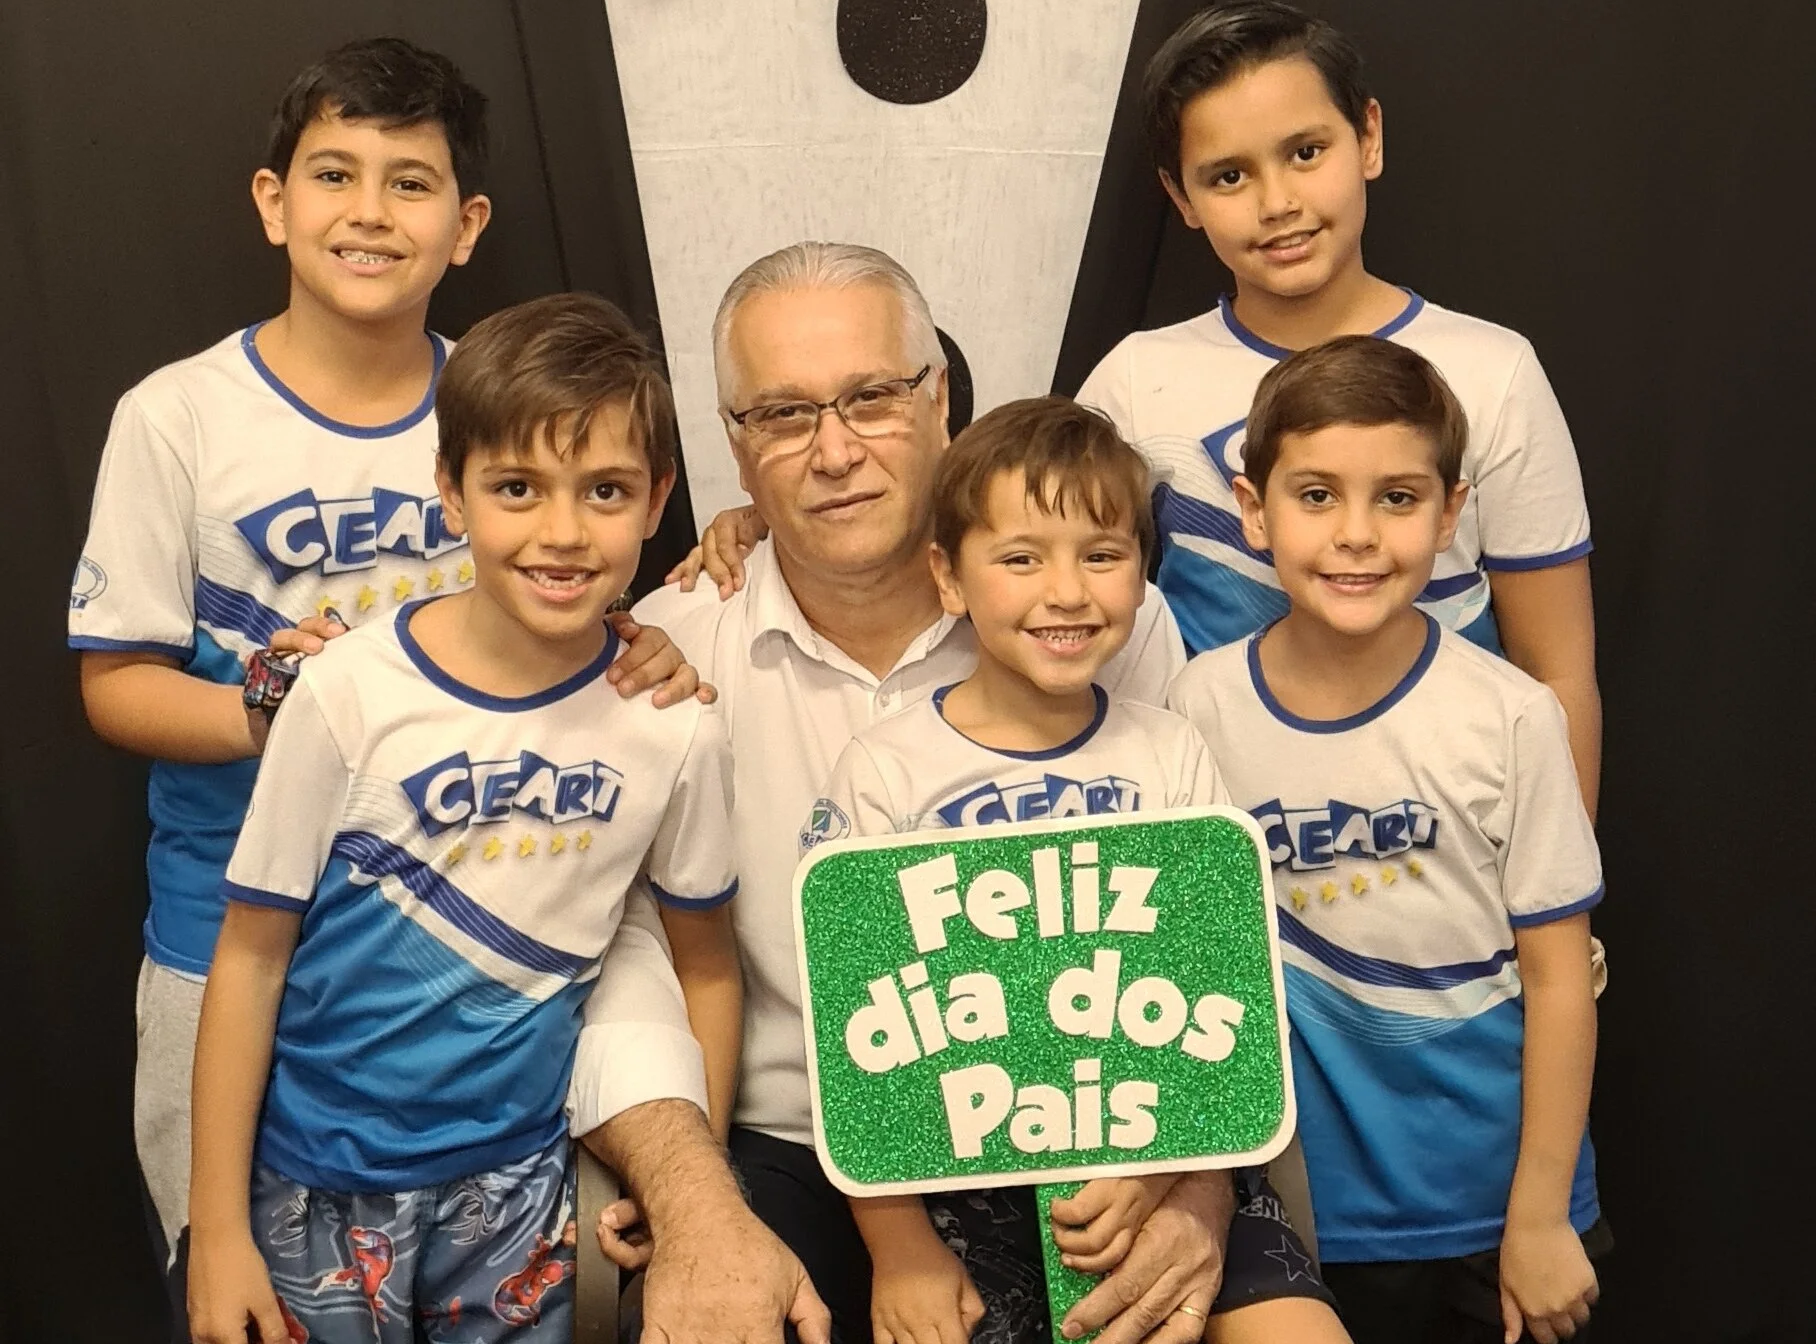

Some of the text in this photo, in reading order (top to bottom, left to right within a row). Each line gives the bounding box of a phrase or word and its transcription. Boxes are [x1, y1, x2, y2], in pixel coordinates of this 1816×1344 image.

[250, 494, 467, 574] CEAR
[412, 756, 624, 830] CEART
[897, 842, 1160, 954] Feliz
[845, 949, 1246, 1073] dia dos
[939, 1059, 1159, 1159] Pais
